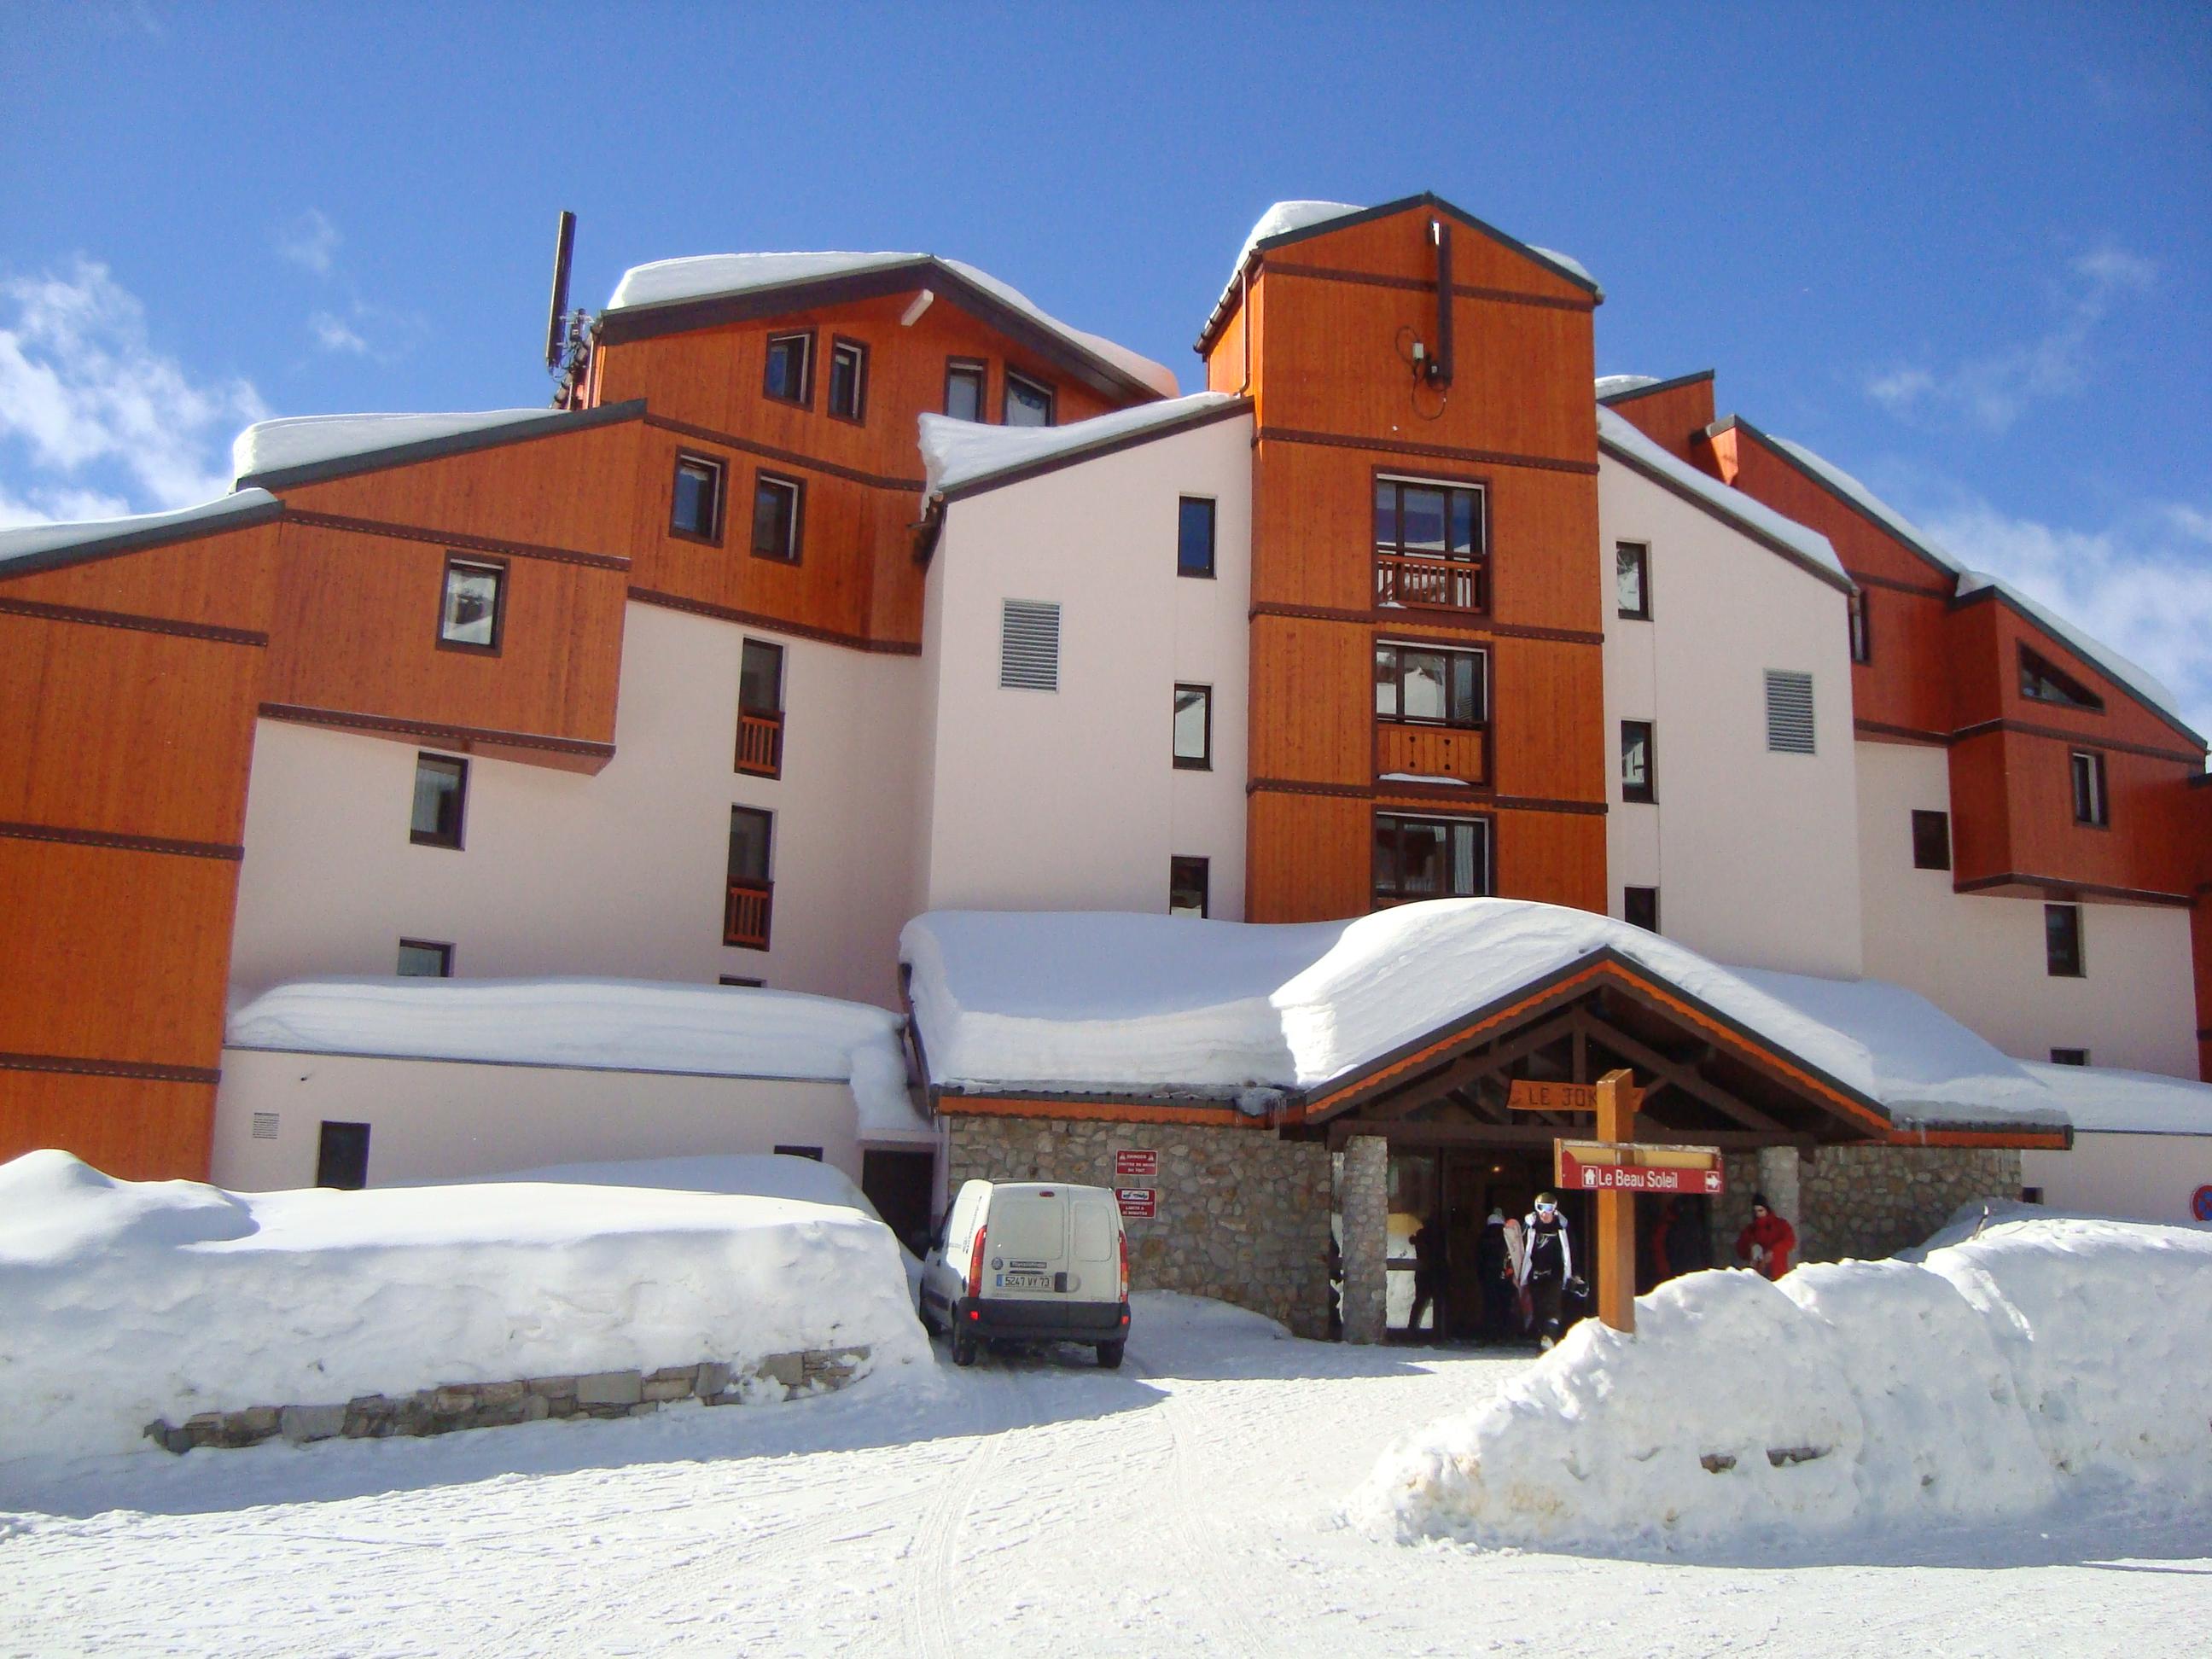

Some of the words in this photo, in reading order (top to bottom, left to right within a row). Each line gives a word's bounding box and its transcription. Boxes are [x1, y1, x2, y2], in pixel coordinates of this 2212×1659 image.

[1528, 1086, 1550, 1106] LE
[1562, 1087, 1598, 1107] JOK
[1598, 1168, 1613, 1187] Le
[1615, 1168, 1645, 1188] Beau
[1647, 1169, 1678, 1189] Soleil
[1005, 1277, 1026, 1287] 5247
[1039, 1278, 1050, 1287] 73
